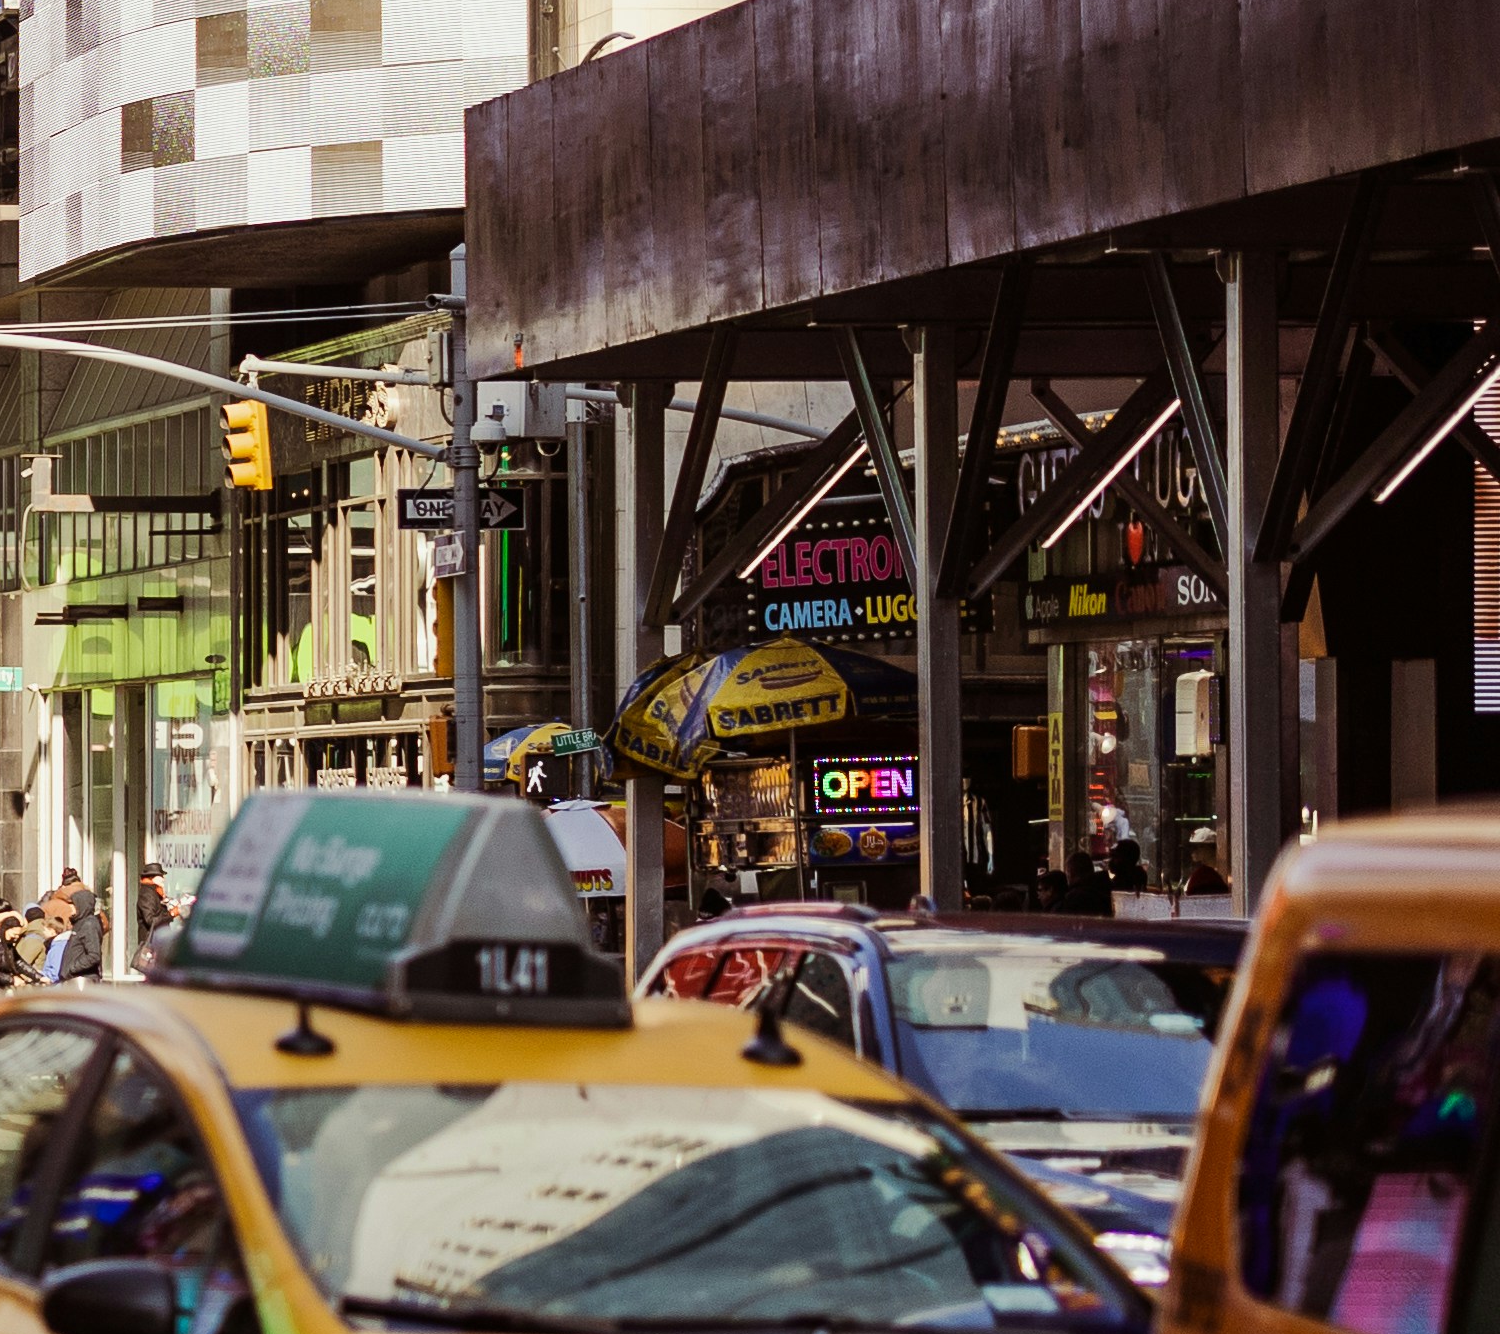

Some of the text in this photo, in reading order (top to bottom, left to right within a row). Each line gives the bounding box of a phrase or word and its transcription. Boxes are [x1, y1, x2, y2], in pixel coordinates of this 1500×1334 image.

[764, 598, 853, 631] CAMERA
[1035, 595, 1059, 624] Apple
[1069, 584, 1107, 616] Nikon
[716, 694, 841, 731] SABRETT
[556, 733, 581, 747] LITTLE
[1051, 716, 1061, 804] ATM
[823, 769, 915, 800] OPEN
